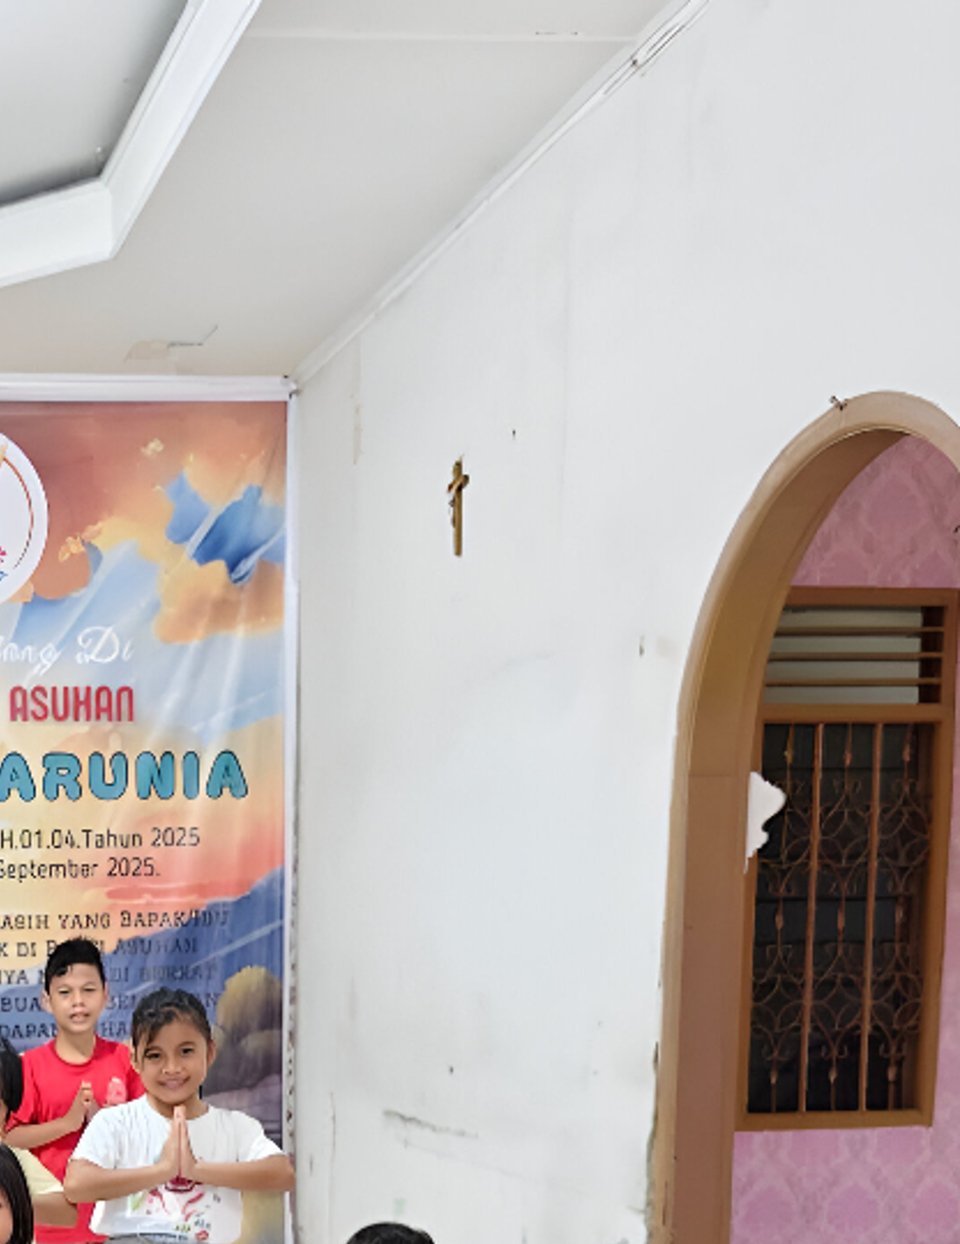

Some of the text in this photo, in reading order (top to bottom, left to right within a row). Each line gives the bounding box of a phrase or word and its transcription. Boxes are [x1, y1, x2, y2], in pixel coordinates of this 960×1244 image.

[76, 624, 134, 664] Di
[9, 685, 135, 723] ASUHAN
[151, 827, 200, 848] 2025
[106, 857, 161, 878] 2025.
[58, 912, 111, 929] YANG
[16, 941, 37, 957] DI
